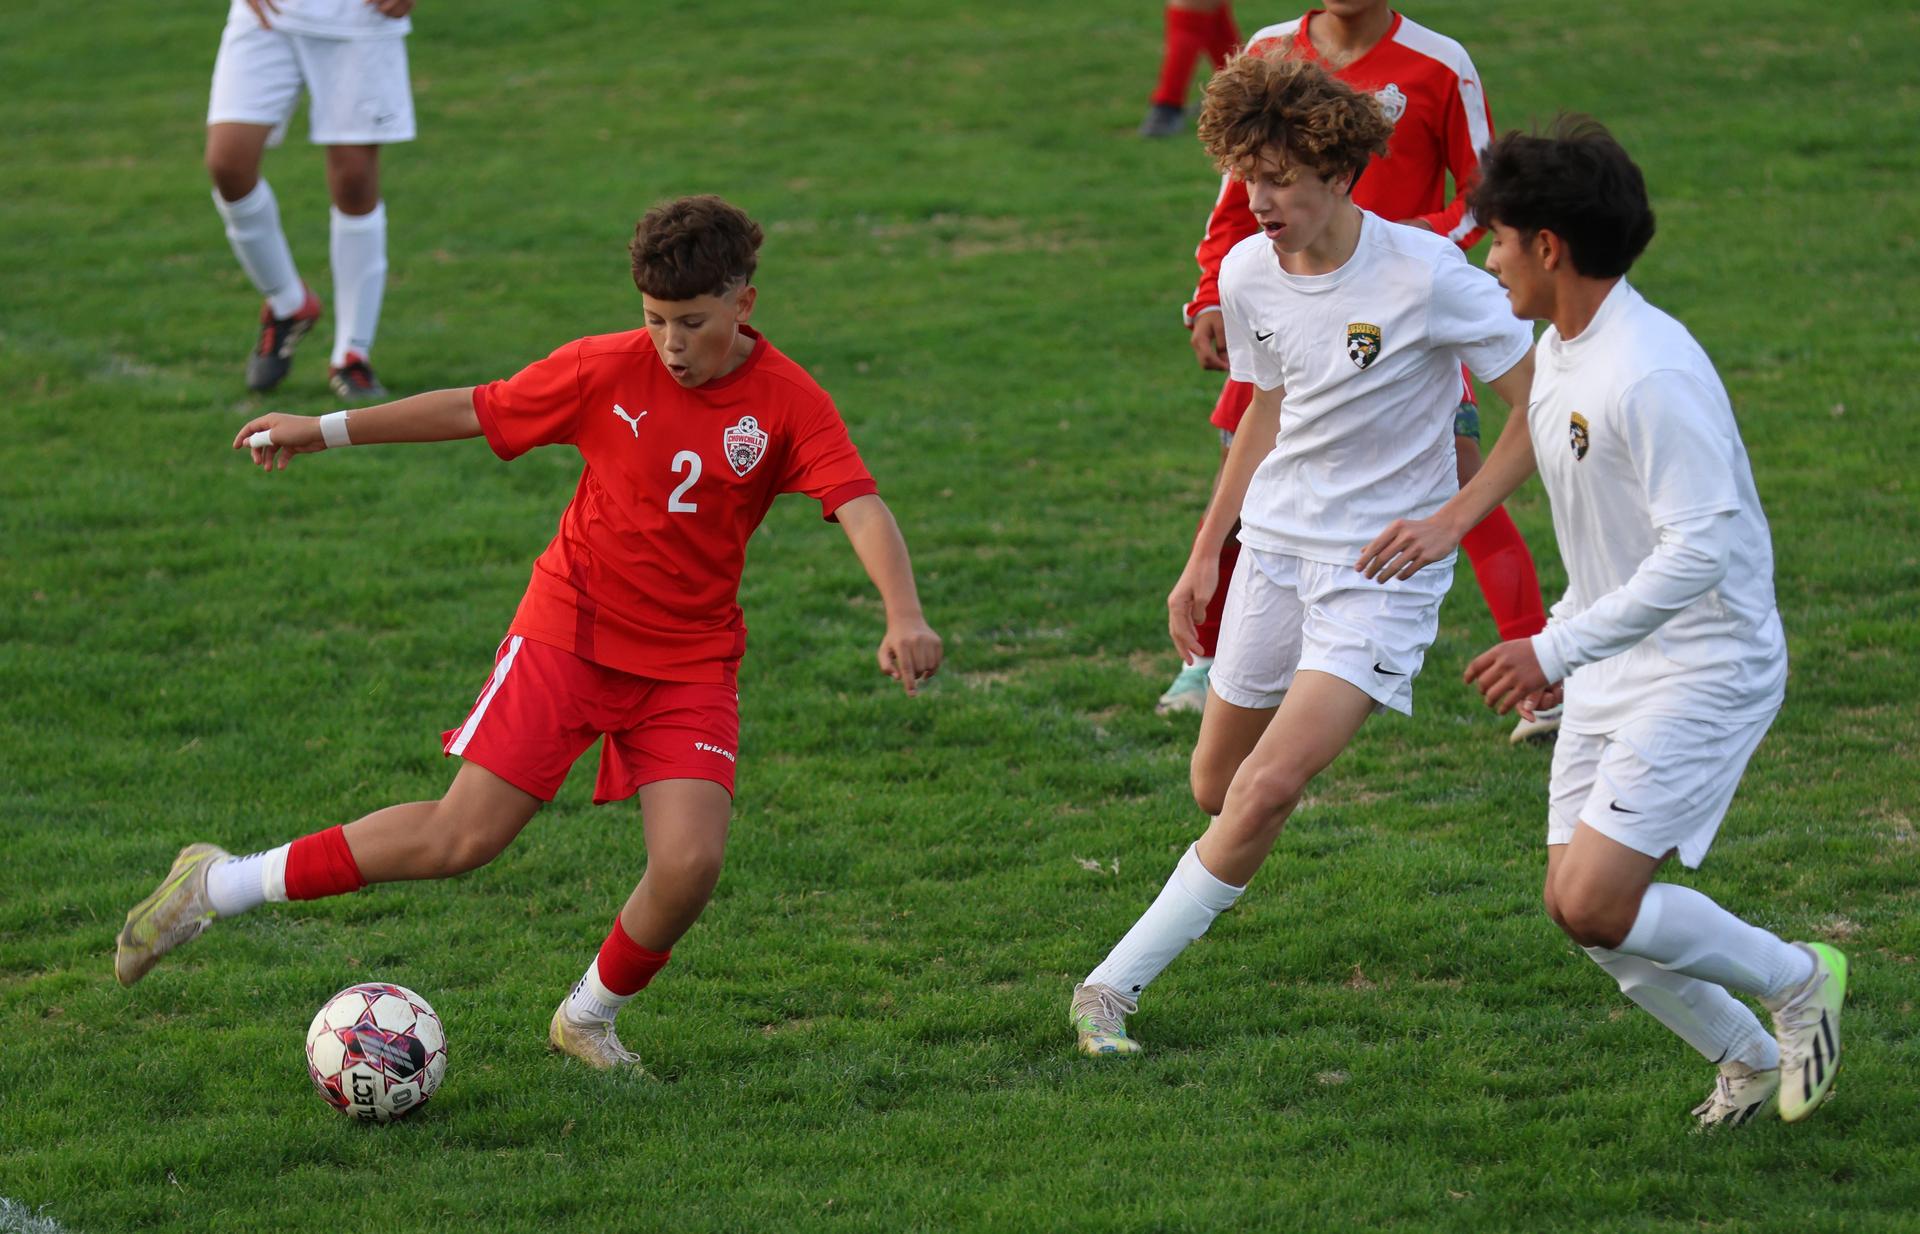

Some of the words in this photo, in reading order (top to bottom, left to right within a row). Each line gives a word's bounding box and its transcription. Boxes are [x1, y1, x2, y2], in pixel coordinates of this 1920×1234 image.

[727, 434, 763, 448] CHOWCHILLA
[668, 450, 702, 513] 2
[352, 1073, 378, 1120] ELECT
